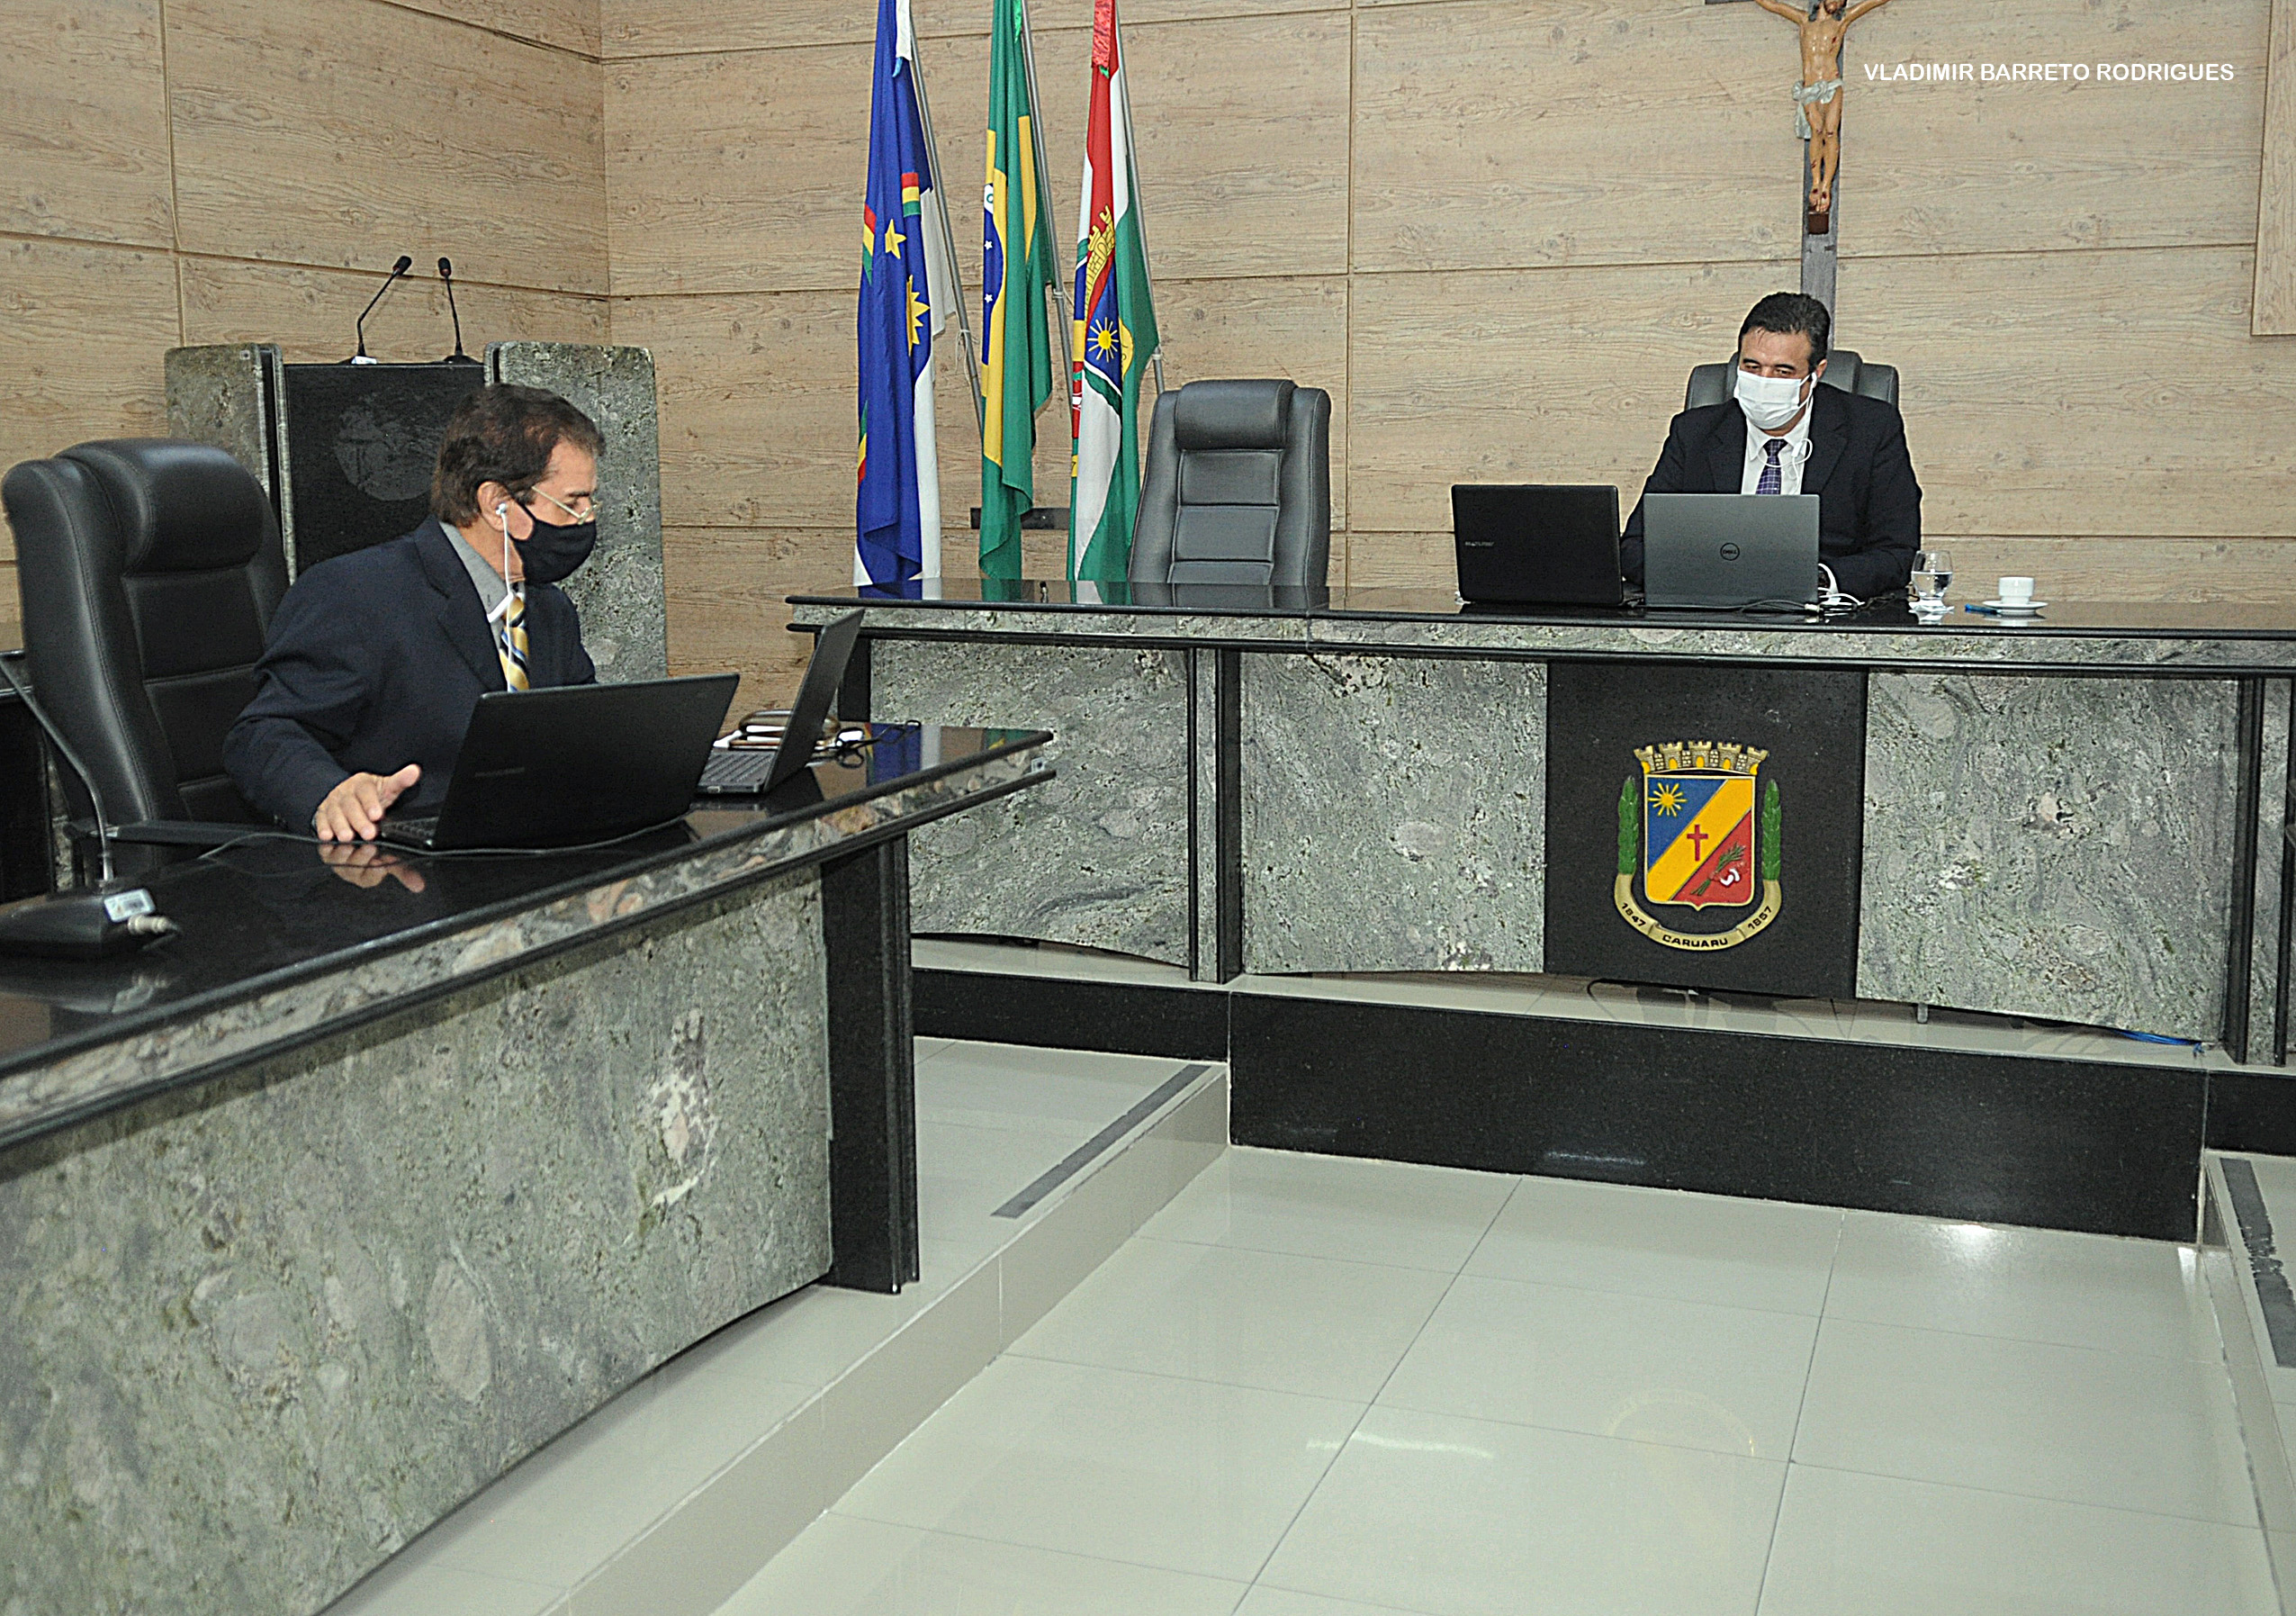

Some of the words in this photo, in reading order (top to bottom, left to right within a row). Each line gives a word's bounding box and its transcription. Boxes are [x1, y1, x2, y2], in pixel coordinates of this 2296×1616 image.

[1621, 903, 1646, 927] 1847
[1662, 934, 1728, 948] CARUARU
[1747, 906, 1772, 930] 1857
